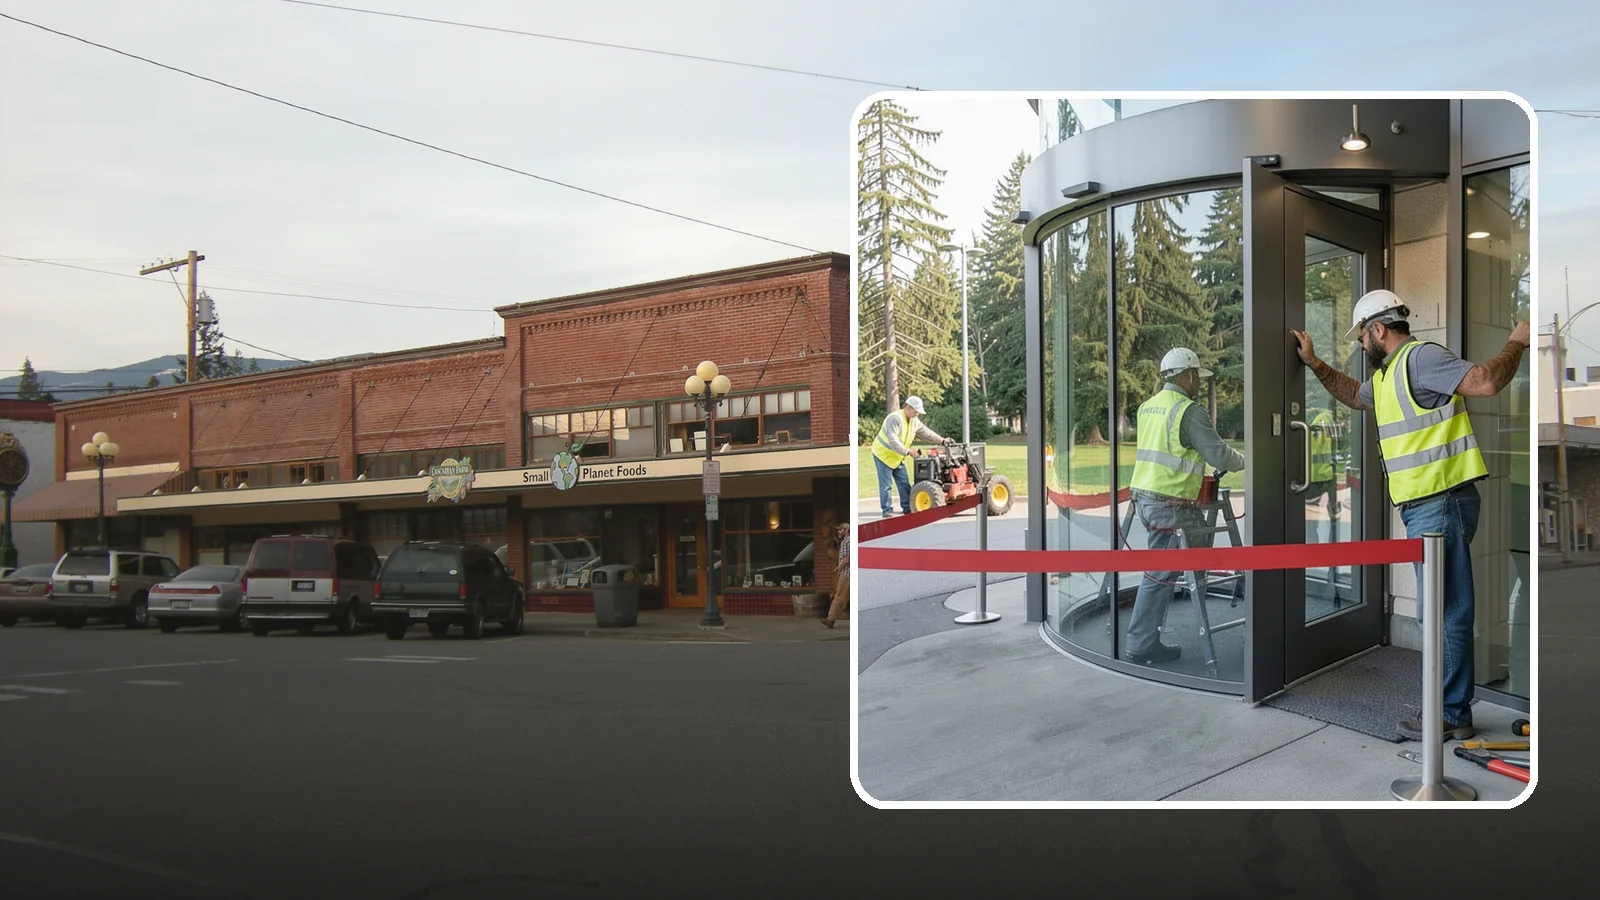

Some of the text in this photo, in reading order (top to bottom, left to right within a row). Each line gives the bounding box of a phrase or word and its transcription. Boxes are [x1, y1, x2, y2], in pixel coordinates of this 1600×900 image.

[523, 464, 647, 483] Small Planet Foods
